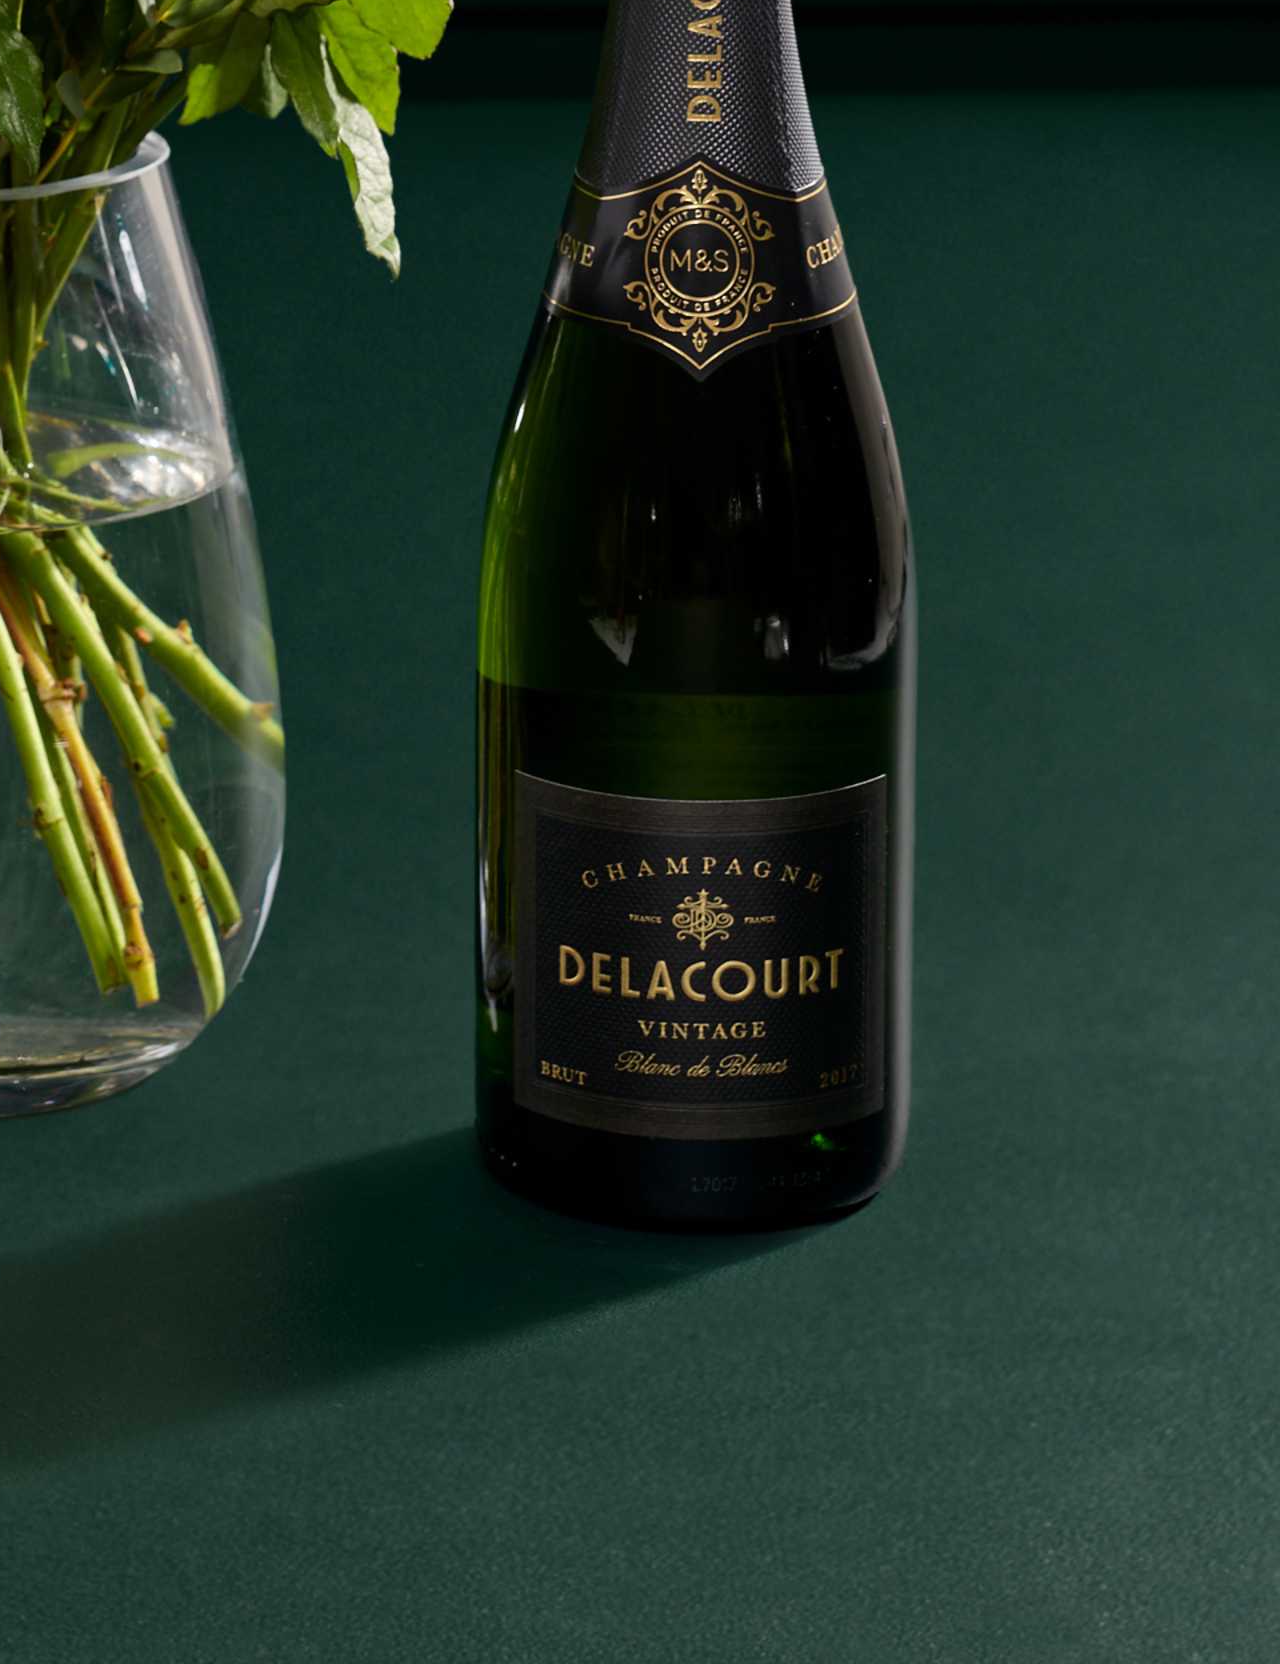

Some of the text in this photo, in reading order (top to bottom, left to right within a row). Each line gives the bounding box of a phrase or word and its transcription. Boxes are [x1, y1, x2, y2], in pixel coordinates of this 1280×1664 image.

[651, 209, 749, 253] PRODUIT DE FRANCE
[670, 248, 729, 273] M&S
[651, 267, 749, 312] PRODUIT DE FRANCE
[581, 856, 824, 893] CHAMPAGNE
[559, 944, 845, 1003] DELACOURT
[638, 1020, 767, 1040] VINTAGE
[540, 1059, 589, 1086] BRUT
[615, 1050, 788, 1077] Blanc de Blancs
